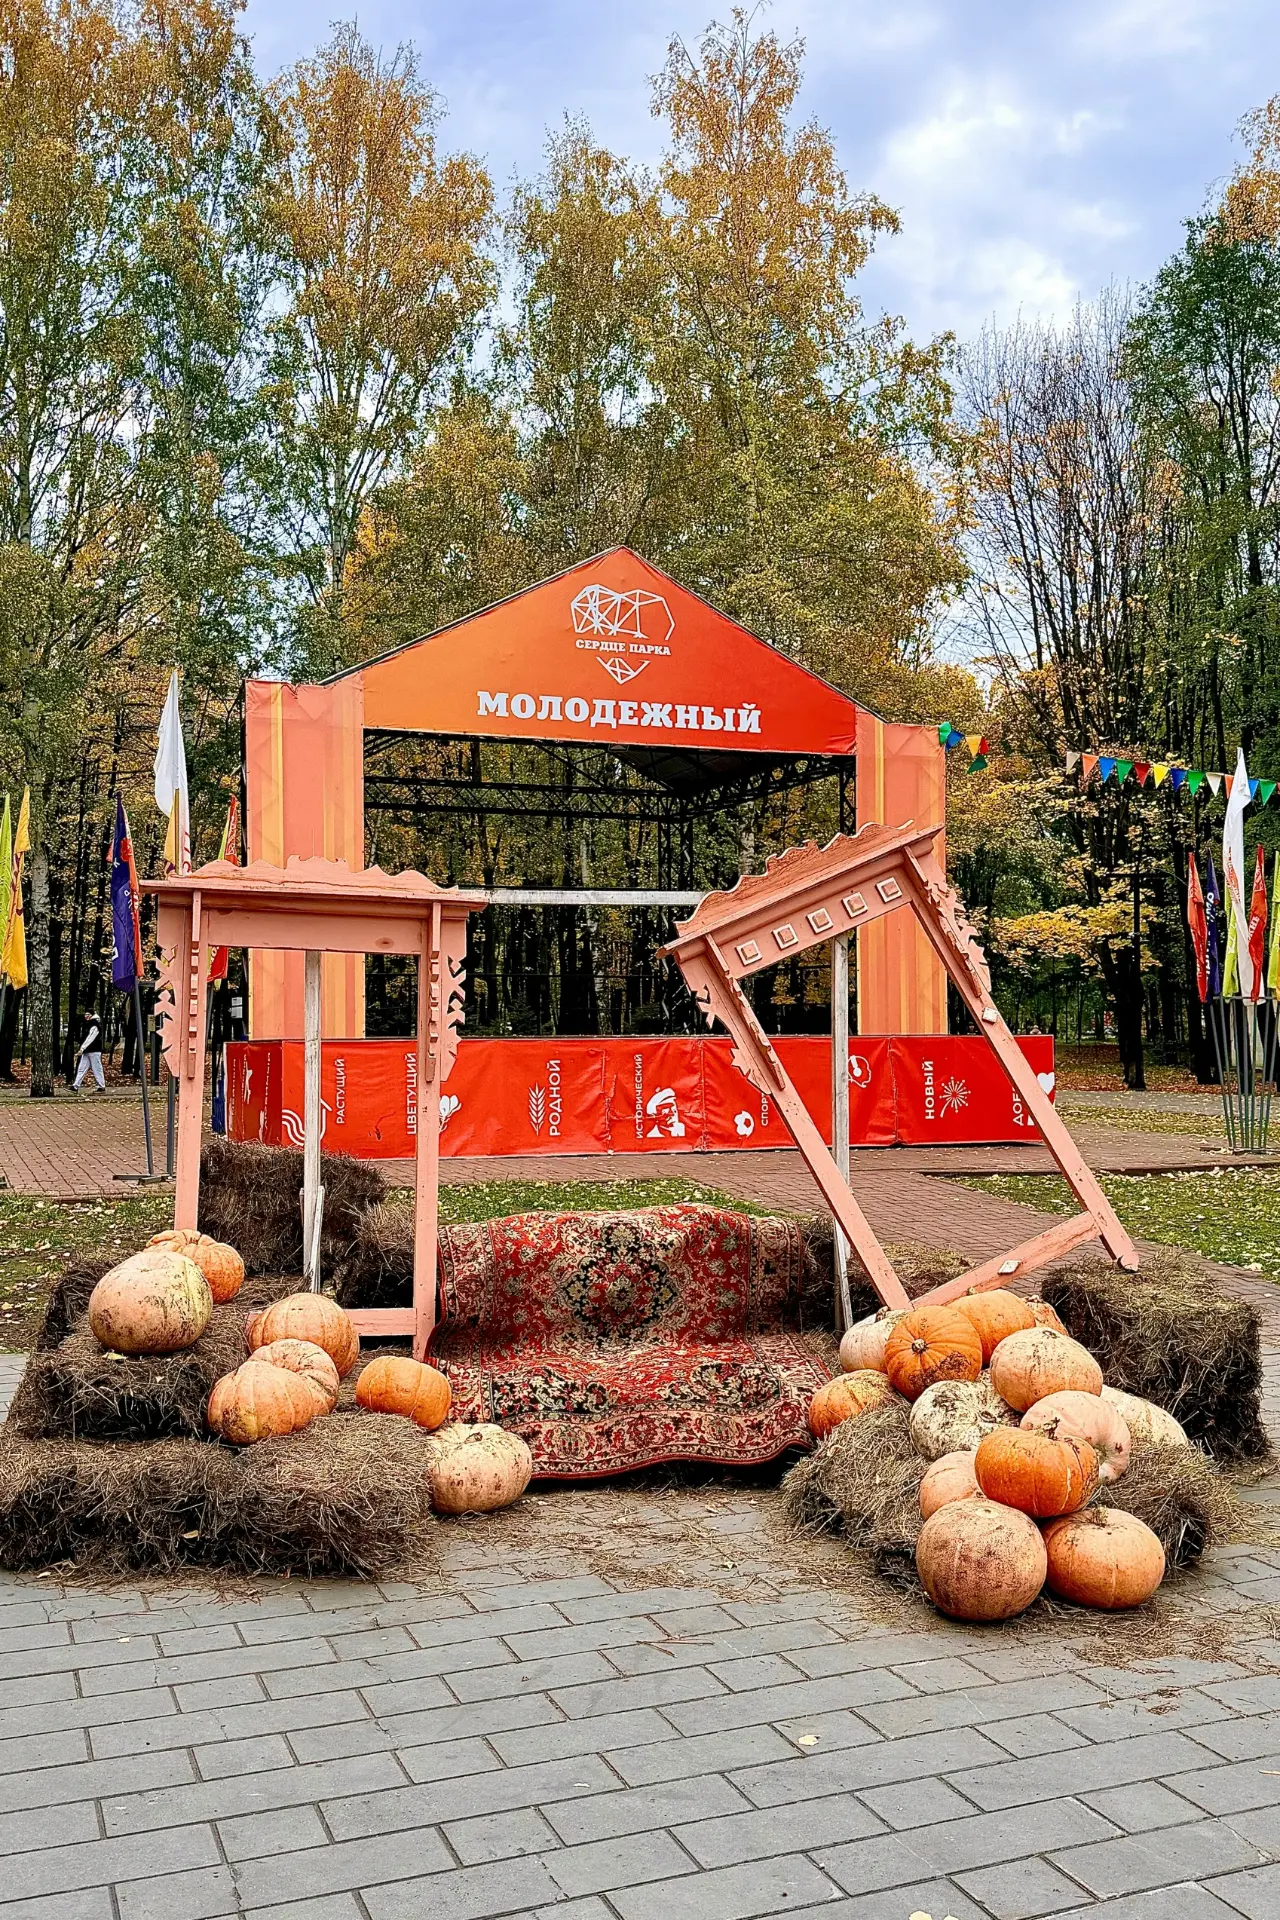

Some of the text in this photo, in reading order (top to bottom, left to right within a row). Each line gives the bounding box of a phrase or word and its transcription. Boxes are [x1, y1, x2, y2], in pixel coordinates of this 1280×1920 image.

[575, 639, 672, 656] СЕРДЦЕ ПАРКА
[477, 690, 762, 733] МОЛОДЕЖНЫЙ
[334, 1058, 347, 1124] РАСТУЩИЙ
[404, 1052, 418, 1135] ЦВЕТУЩИЙ
[546, 1059, 563, 1136] РОДНОЙ
[633, 1053, 644, 1139] ИСТОРИЧЕСКИЙ
[921, 1060, 935, 1120] НОВЫЙ
